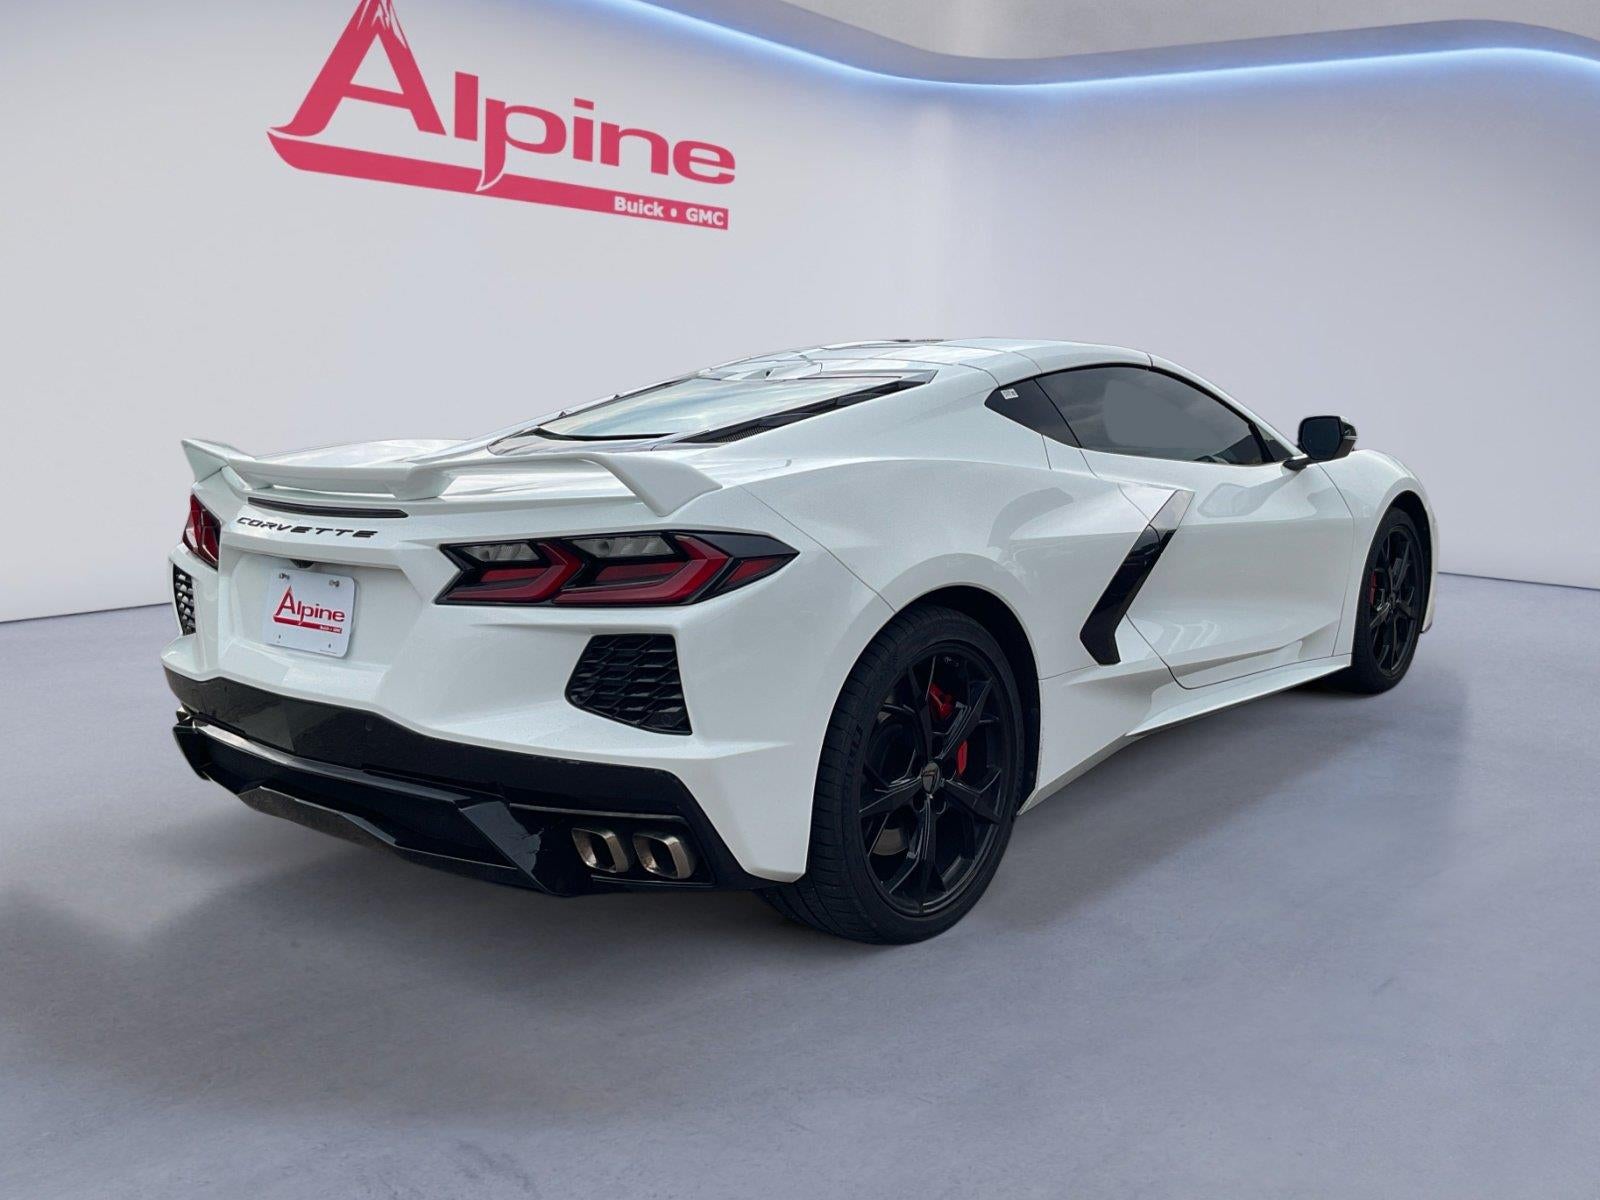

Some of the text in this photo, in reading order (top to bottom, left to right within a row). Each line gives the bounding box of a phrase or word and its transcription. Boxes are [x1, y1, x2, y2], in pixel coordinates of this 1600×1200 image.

[268, 0, 735, 191] Alpine
[614, 196, 724, 226] Buick GMC
[236, 516, 378, 538] CORVETTE
[274, 585, 345, 625] Alpine
